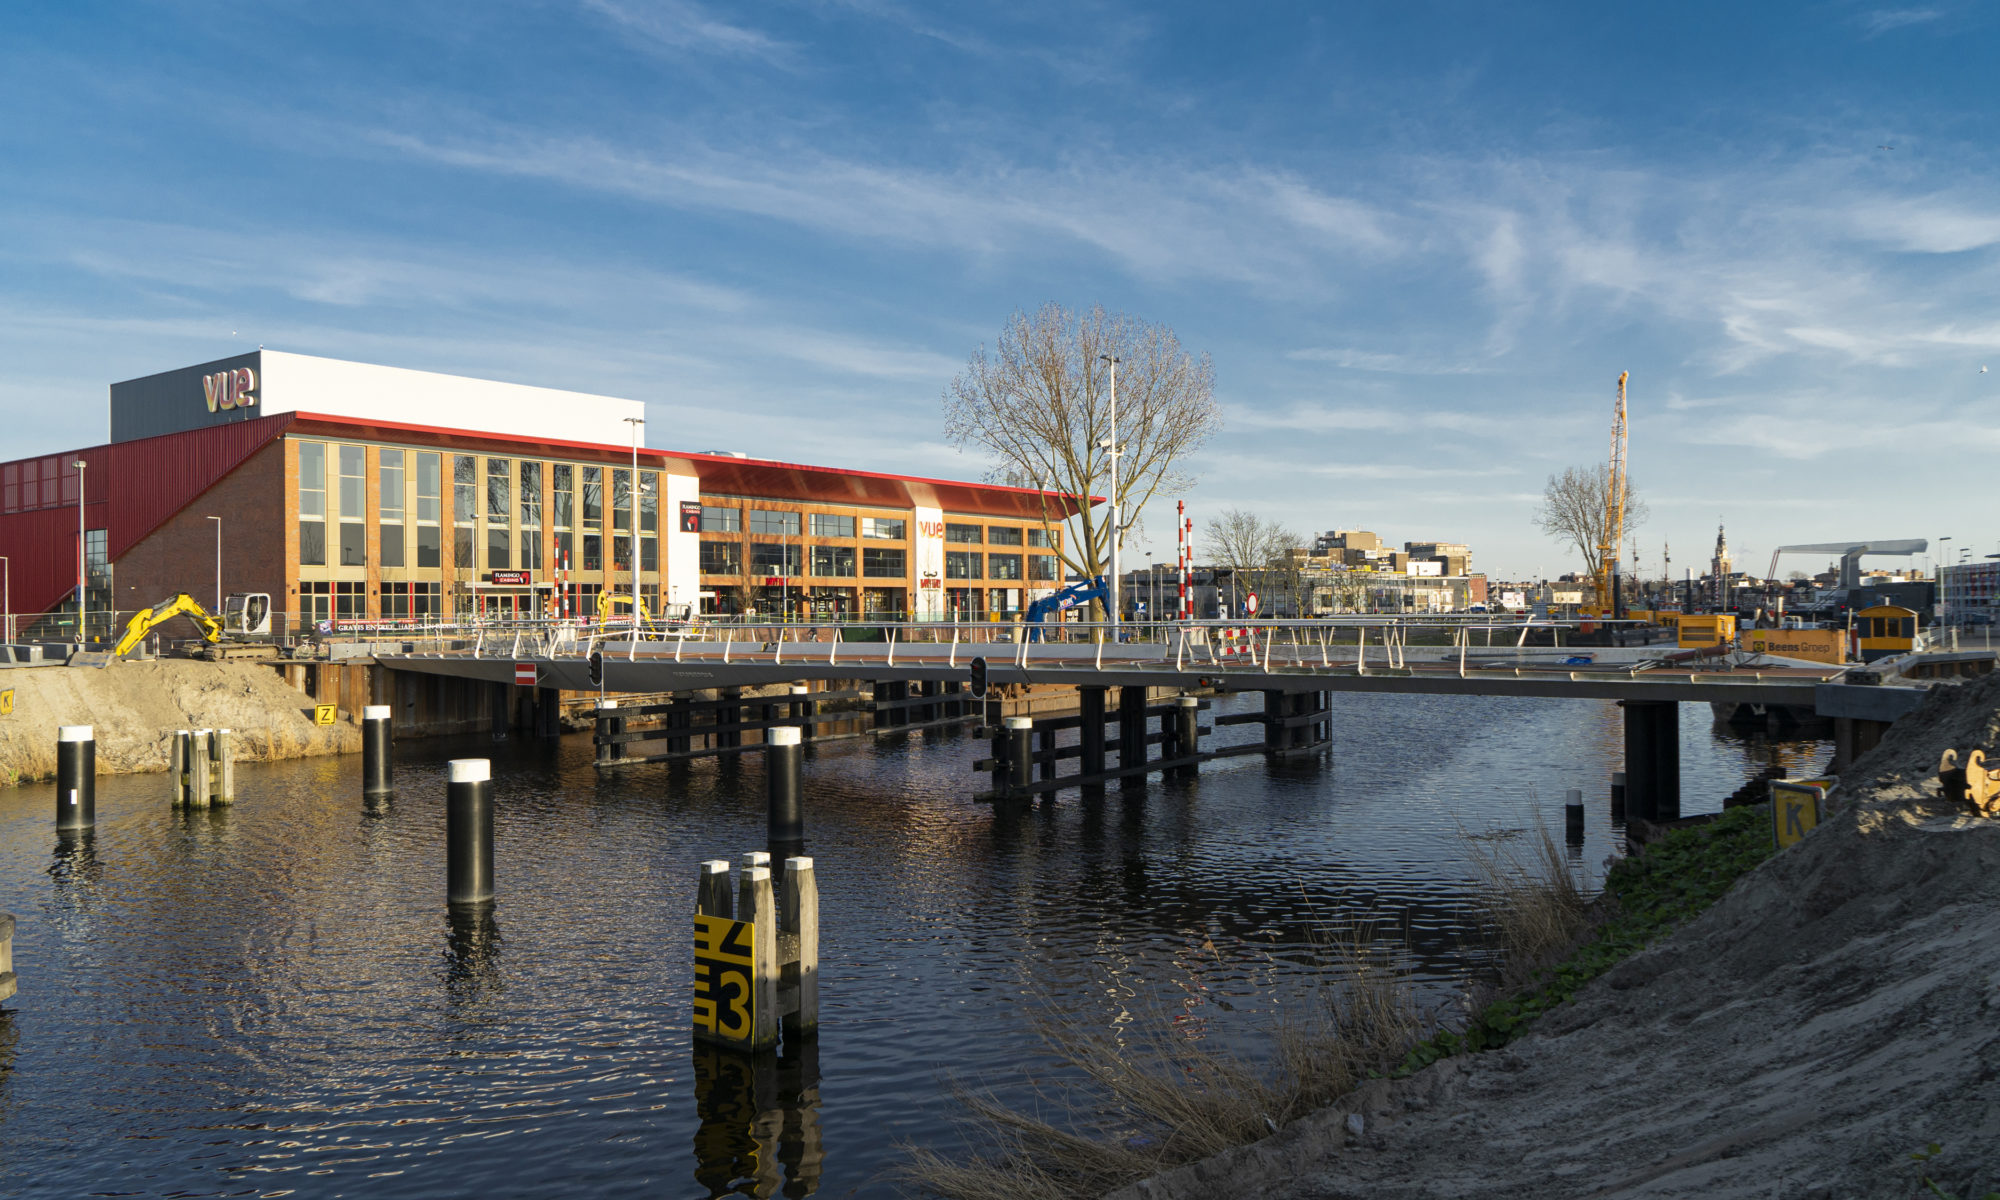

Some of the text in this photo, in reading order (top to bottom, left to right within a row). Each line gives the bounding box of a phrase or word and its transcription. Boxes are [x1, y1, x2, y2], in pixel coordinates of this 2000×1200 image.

[1768, 642, 1830, 654] Beens Groep
[3, 695, 10, 708] K
[321, 708, 331, 721] Z
[1785, 802, 1805, 838] K
[719, 970, 751, 1041] 3
